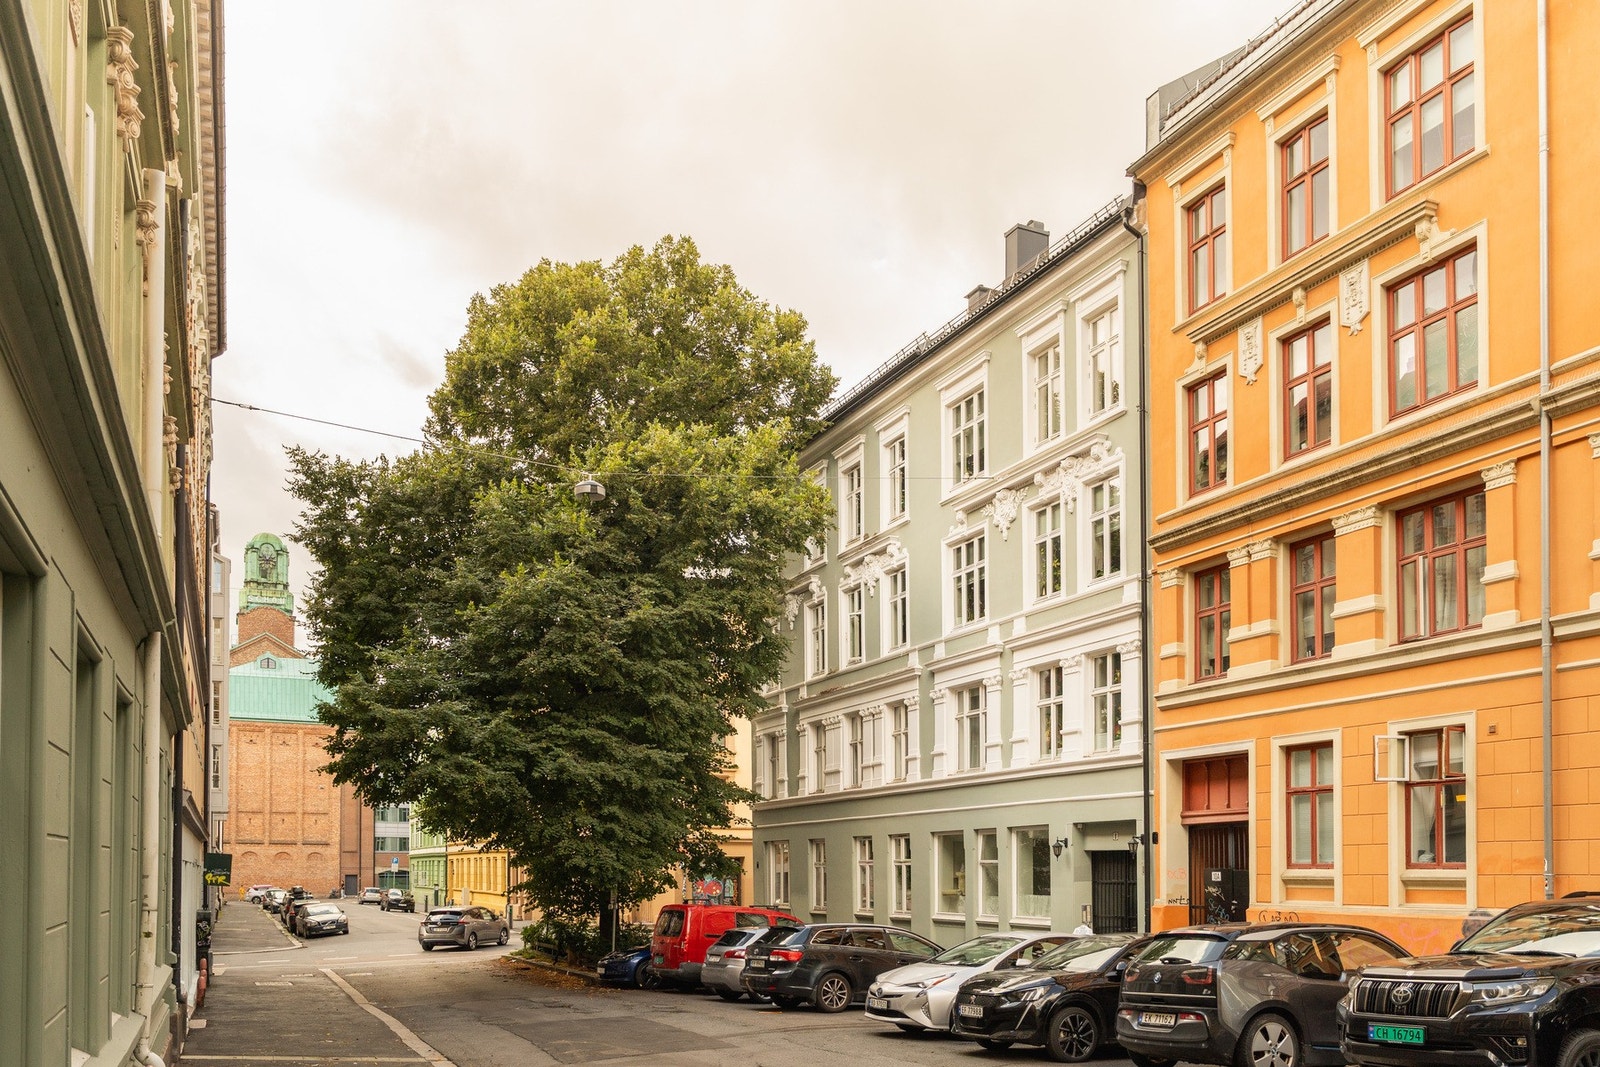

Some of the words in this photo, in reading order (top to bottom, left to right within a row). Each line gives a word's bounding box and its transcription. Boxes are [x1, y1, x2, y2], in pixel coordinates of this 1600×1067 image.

[1144, 1013, 1152, 1022] EK
[1154, 1014, 1173, 1024] 71162
[1376, 1028, 1388, 1039] CH
[1392, 1029, 1421, 1041] 16794
